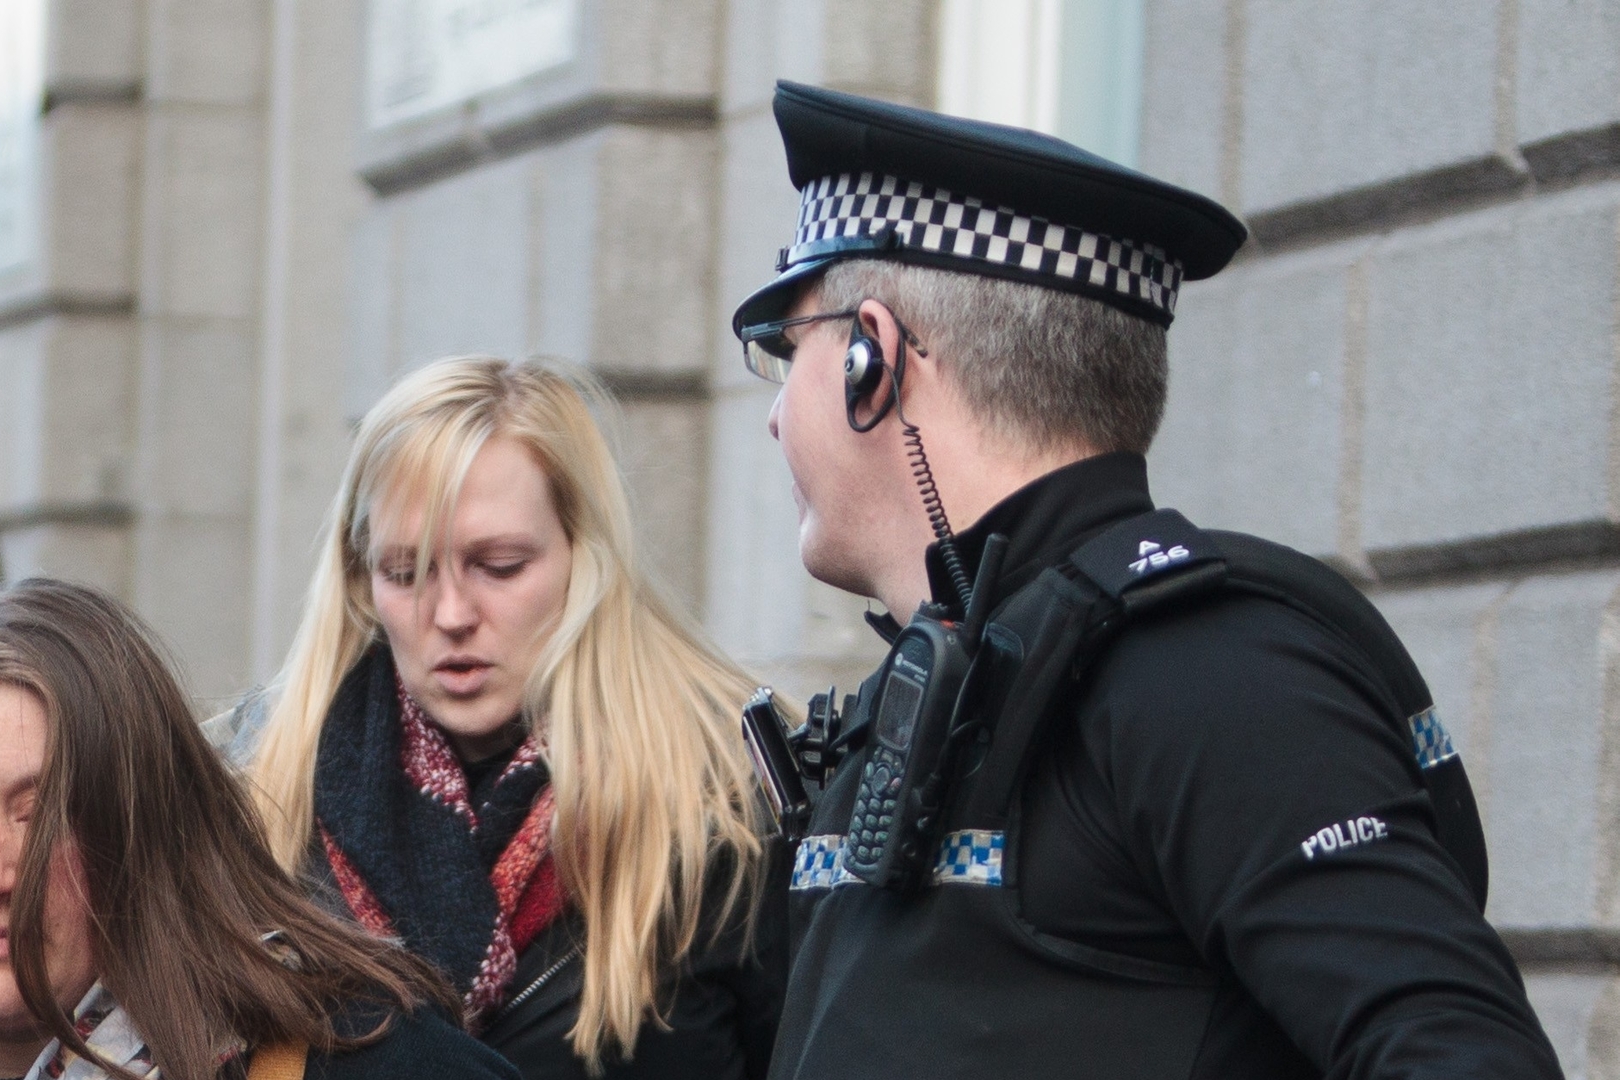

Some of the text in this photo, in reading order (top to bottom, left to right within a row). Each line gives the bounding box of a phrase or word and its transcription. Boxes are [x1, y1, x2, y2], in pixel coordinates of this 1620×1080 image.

[1128, 545, 1190, 572] 756
[1138, 540, 1160, 556] A
[1301, 816, 1388, 860] POLICE
